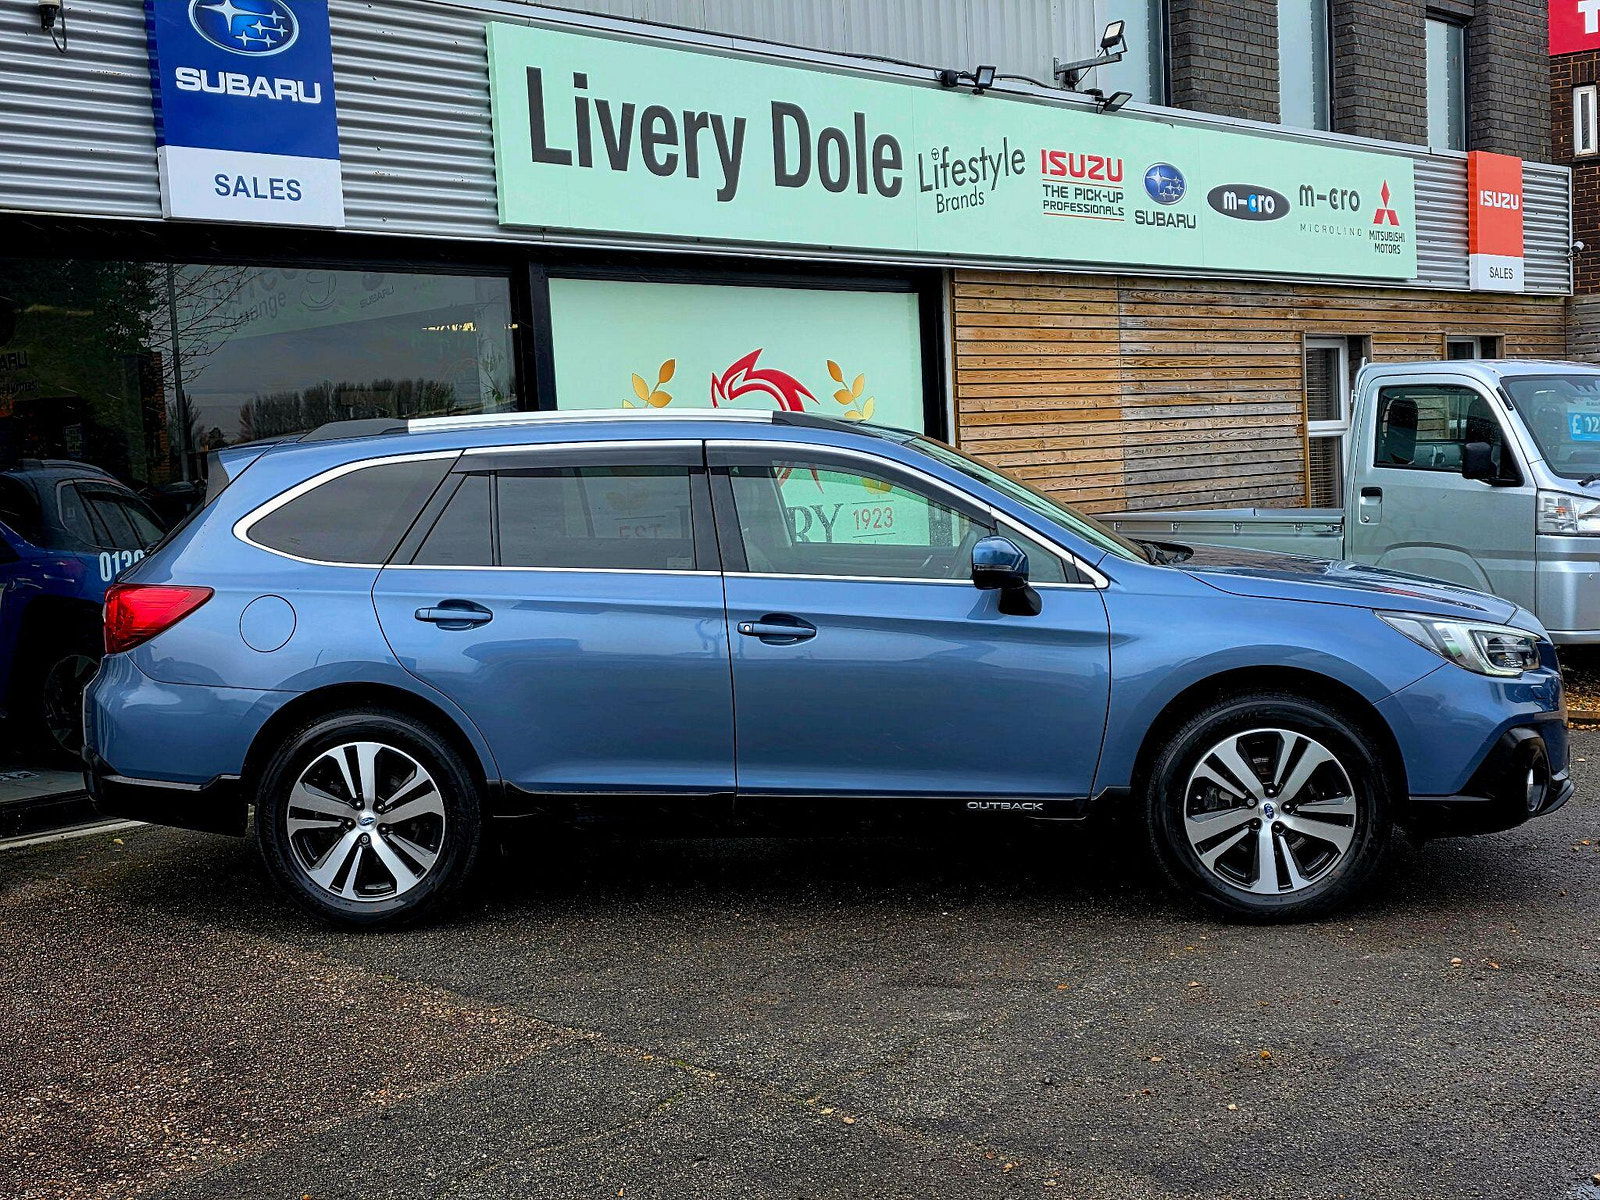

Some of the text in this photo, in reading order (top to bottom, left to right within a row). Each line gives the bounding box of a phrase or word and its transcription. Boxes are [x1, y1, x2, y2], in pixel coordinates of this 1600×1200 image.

[175, 66, 321, 104] SUBARU
[526, 66, 903, 202] Livery Dole
[918, 136, 1026, 192] Lifestyle
[1040, 149, 1124, 183] ISUZU
[214, 174, 302, 202] SALES
[1042, 184, 1124, 204] THE PICK-UP
[936, 186, 985, 213] Brands
[1043, 199, 1125, 217] PROFESSIONALS
[1479, 189, 1520, 210] ISUZU
[1134, 209, 1197, 230] SUBARU
[1368, 229, 1406, 243] MITSUBISHI
[1374, 242, 1402, 255] MOTORS
[1489, 266, 1514, 280] SALES
[852, 506, 895, 531] 1923
[966, 801, 1044, 811] OUTBACK
